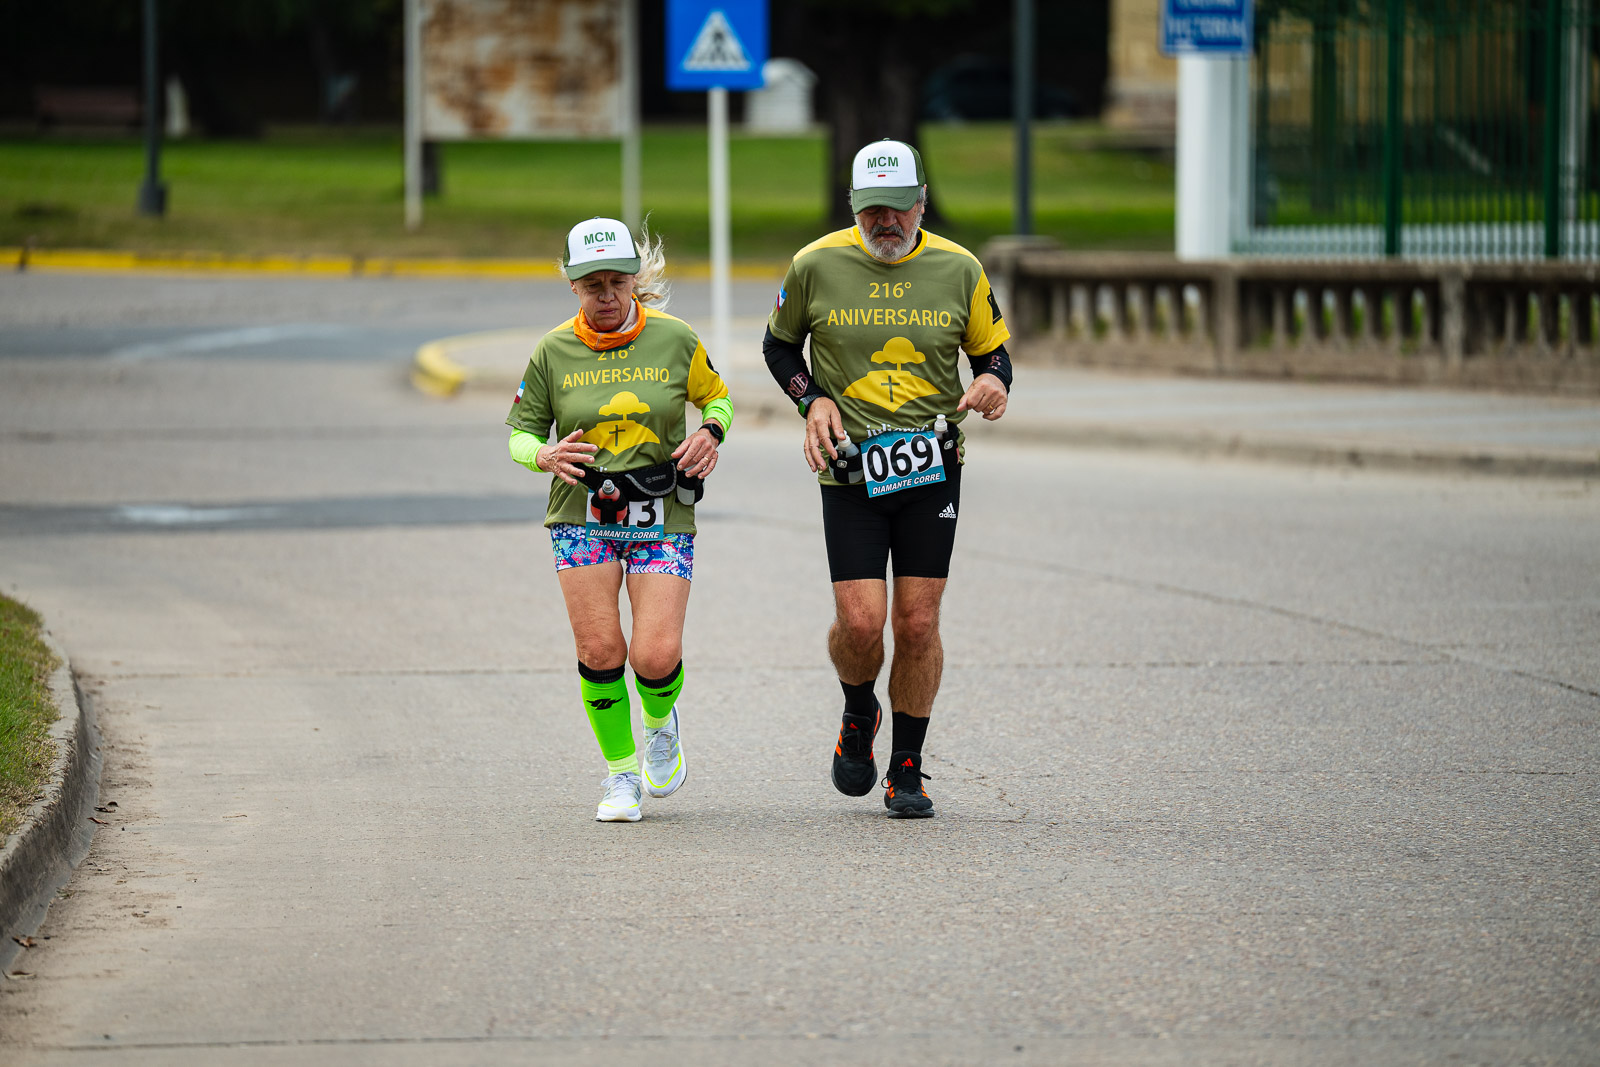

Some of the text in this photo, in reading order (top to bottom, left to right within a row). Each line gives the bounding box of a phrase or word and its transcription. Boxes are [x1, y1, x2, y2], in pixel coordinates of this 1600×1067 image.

[867, 156, 899, 168] MCM
[584, 231, 616, 245] MCM
[868, 281, 912, 298] 216°
[827, 308, 952, 328] ANIVERSARIO
[562, 367, 670, 389] ANIVERSARIO
[866, 434, 934, 484] 069
[872, 472, 941, 495] DIAMANTE CORRE
[589, 529, 660, 539] DIAMANTE CORRE
